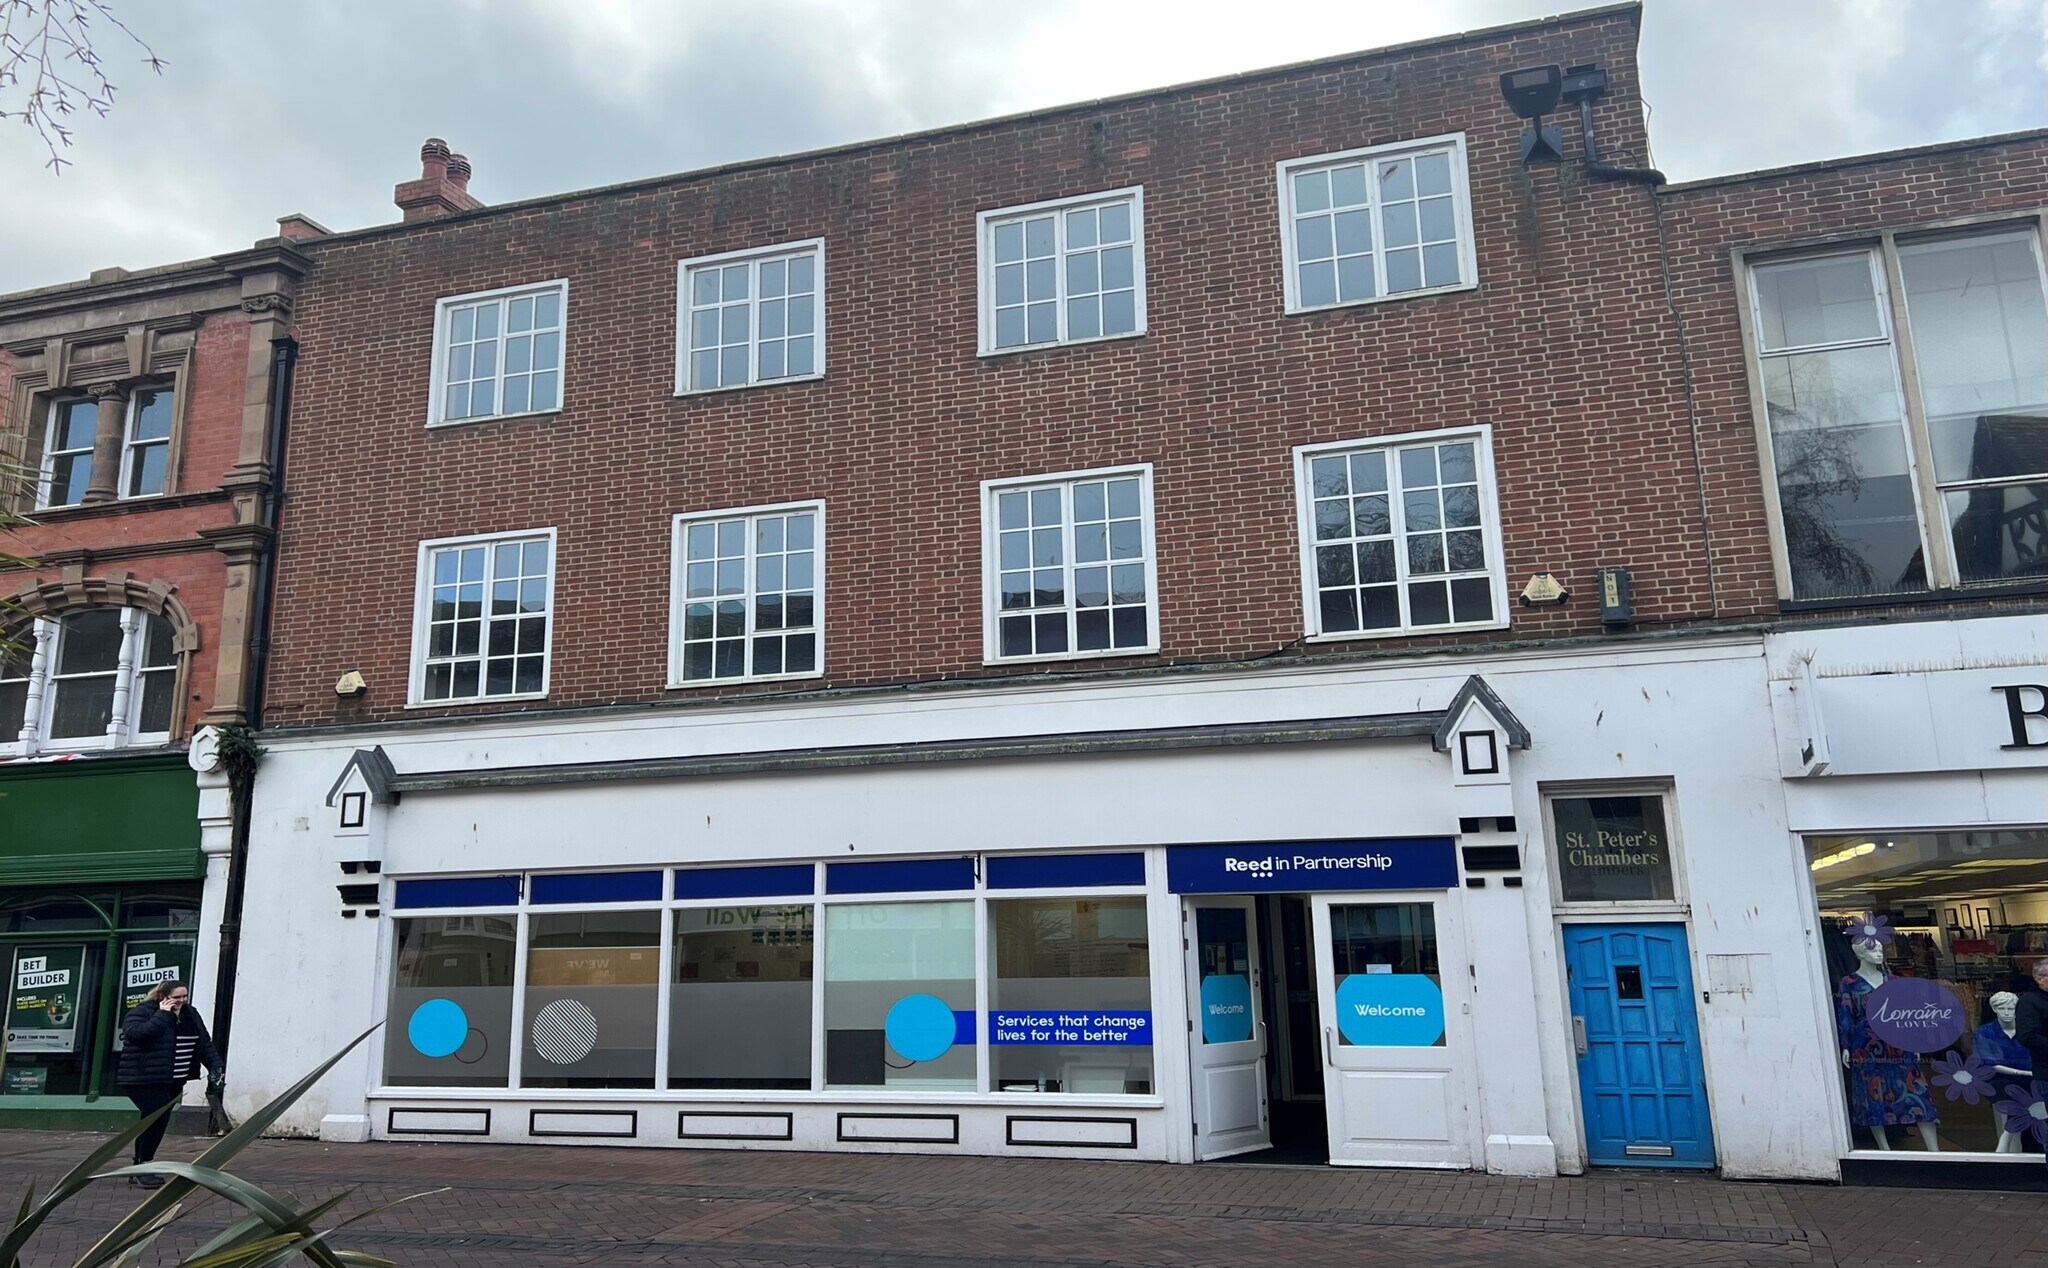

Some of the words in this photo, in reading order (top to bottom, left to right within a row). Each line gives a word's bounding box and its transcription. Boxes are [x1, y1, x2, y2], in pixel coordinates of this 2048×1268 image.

[1566, 832, 1590, 848] St.
[1597, 830, 1658, 848] Peter's
[1225, 856, 1273, 872] Reed
[1276, 856, 1290, 871] in
[1293, 853, 1393, 873] Partnership
[1569, 849, 1659, 867] Chambers
[23, 960, 42, 971] BET
[132, 957, 151, 968] BET
[22, 973, 65, 987] BUILDER
[132, 970, 174, 984] BUILDER
[1209, 1003, 1244, 1016] Welcome
[1354, 1004, 1426, 1017] Welcome
[1871, 997, 1952, 1023] Lorraine
[997, 1015, 1055, 1027] Services
[1058, 1015, 1089, 1027] that
[1094, 1015, 1146, 1031] change
[1895, 1020, 1939, 1029] LOVES
[997, 1029, 1027, 1042] lives
[1031, 1029, 1050, 1042] for
[1054, 1029, 1079, 1042] the
[1083, 1029, 1128, 1042] better
